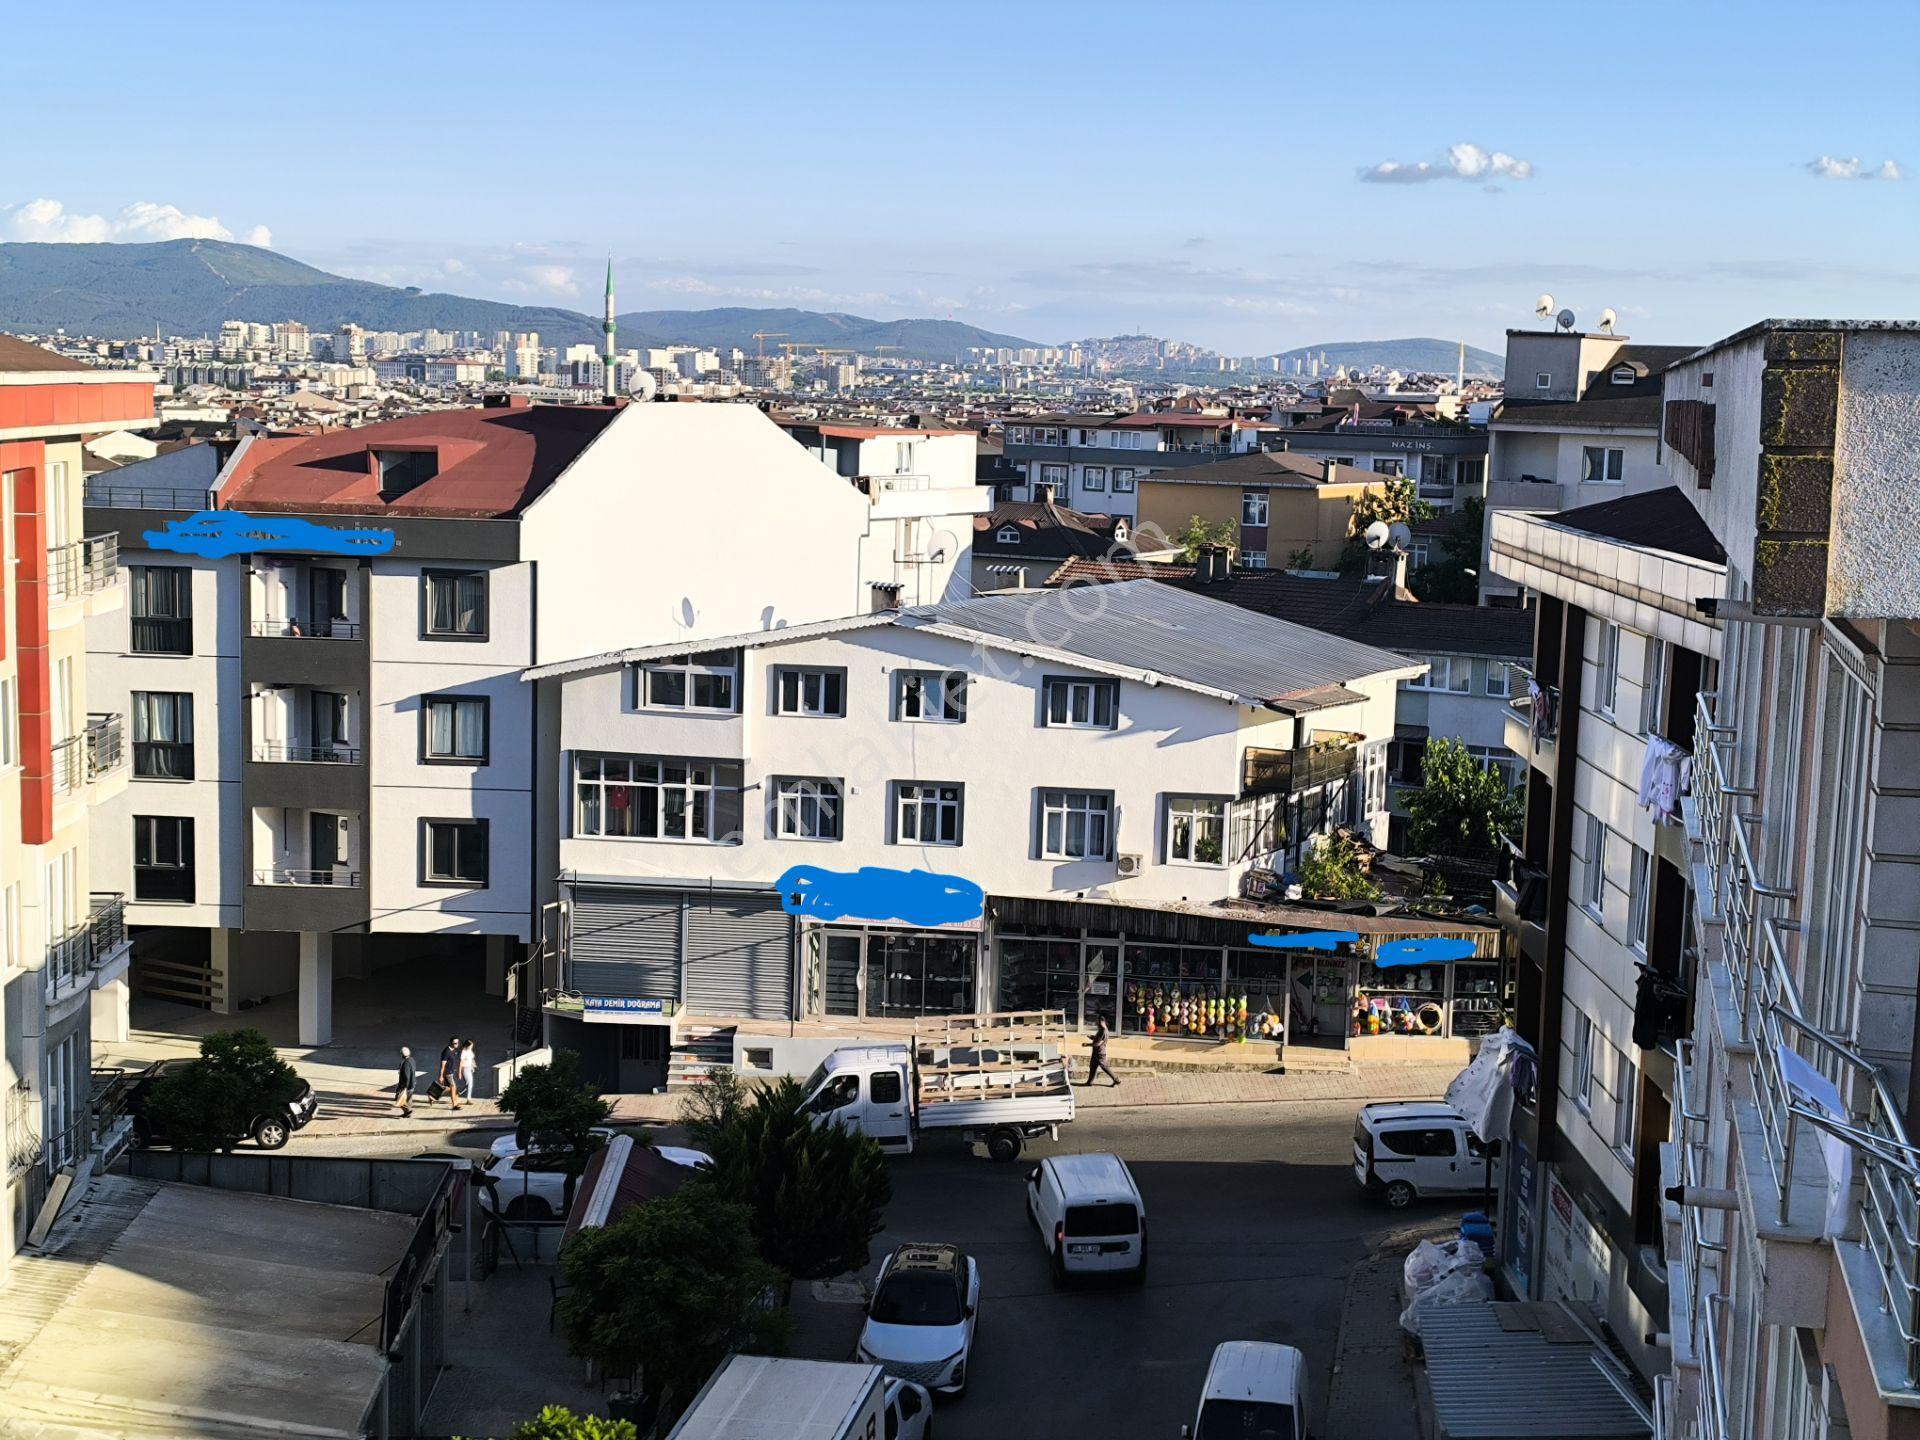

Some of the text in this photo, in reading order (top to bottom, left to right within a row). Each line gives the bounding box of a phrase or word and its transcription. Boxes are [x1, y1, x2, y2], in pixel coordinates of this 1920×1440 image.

[1391, 441, 1413, 449] NAZ
[585, 998, 661, 1009] KAYA DEMİR DOĞRAMA
